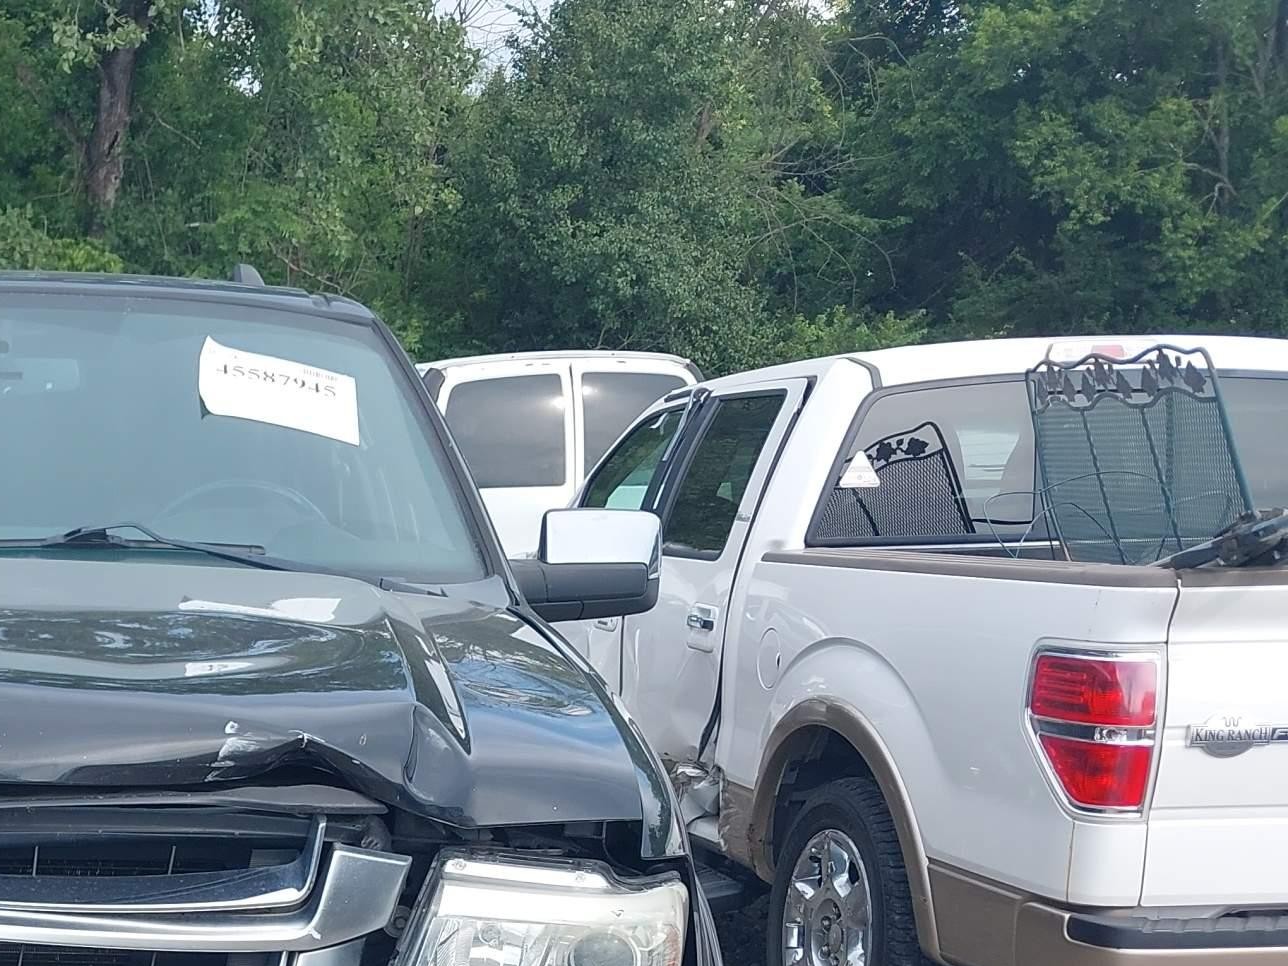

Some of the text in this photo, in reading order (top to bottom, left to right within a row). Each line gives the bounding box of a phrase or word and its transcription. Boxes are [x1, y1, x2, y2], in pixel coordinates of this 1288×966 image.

[216, 363, 337, 398] 45587945
[1195, 728, 1224, 742] KING
[1227, 727, 1271, 741] RANCH
